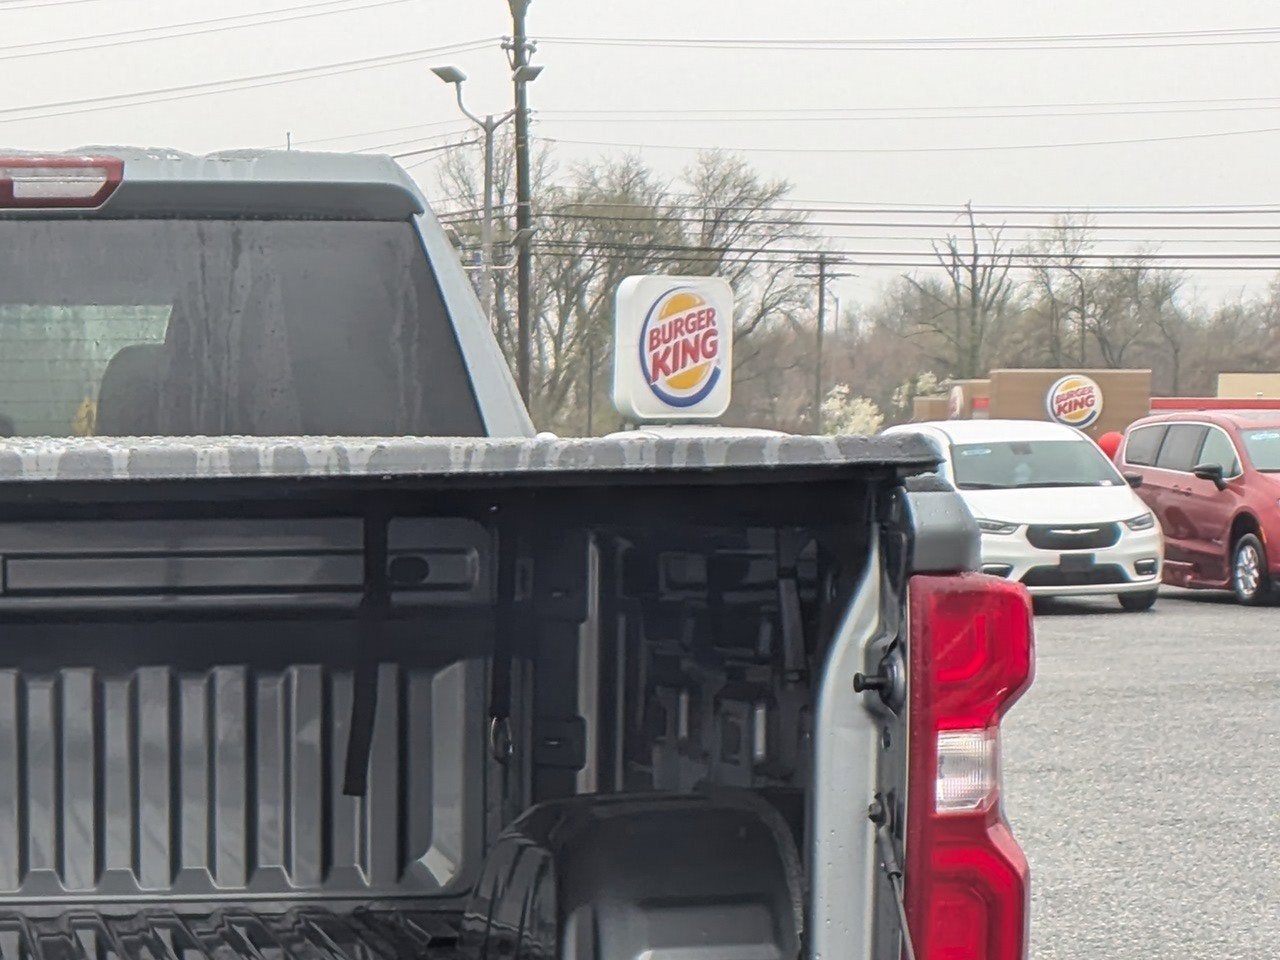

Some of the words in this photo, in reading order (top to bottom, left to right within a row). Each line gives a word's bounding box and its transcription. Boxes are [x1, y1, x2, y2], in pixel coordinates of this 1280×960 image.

[649, 307, 717, 352] BURGER
[649, 328, 719, 385] KING
[1055, 386, 1094, 404] BURGER
[1055, 394, 1095, 417] KING
